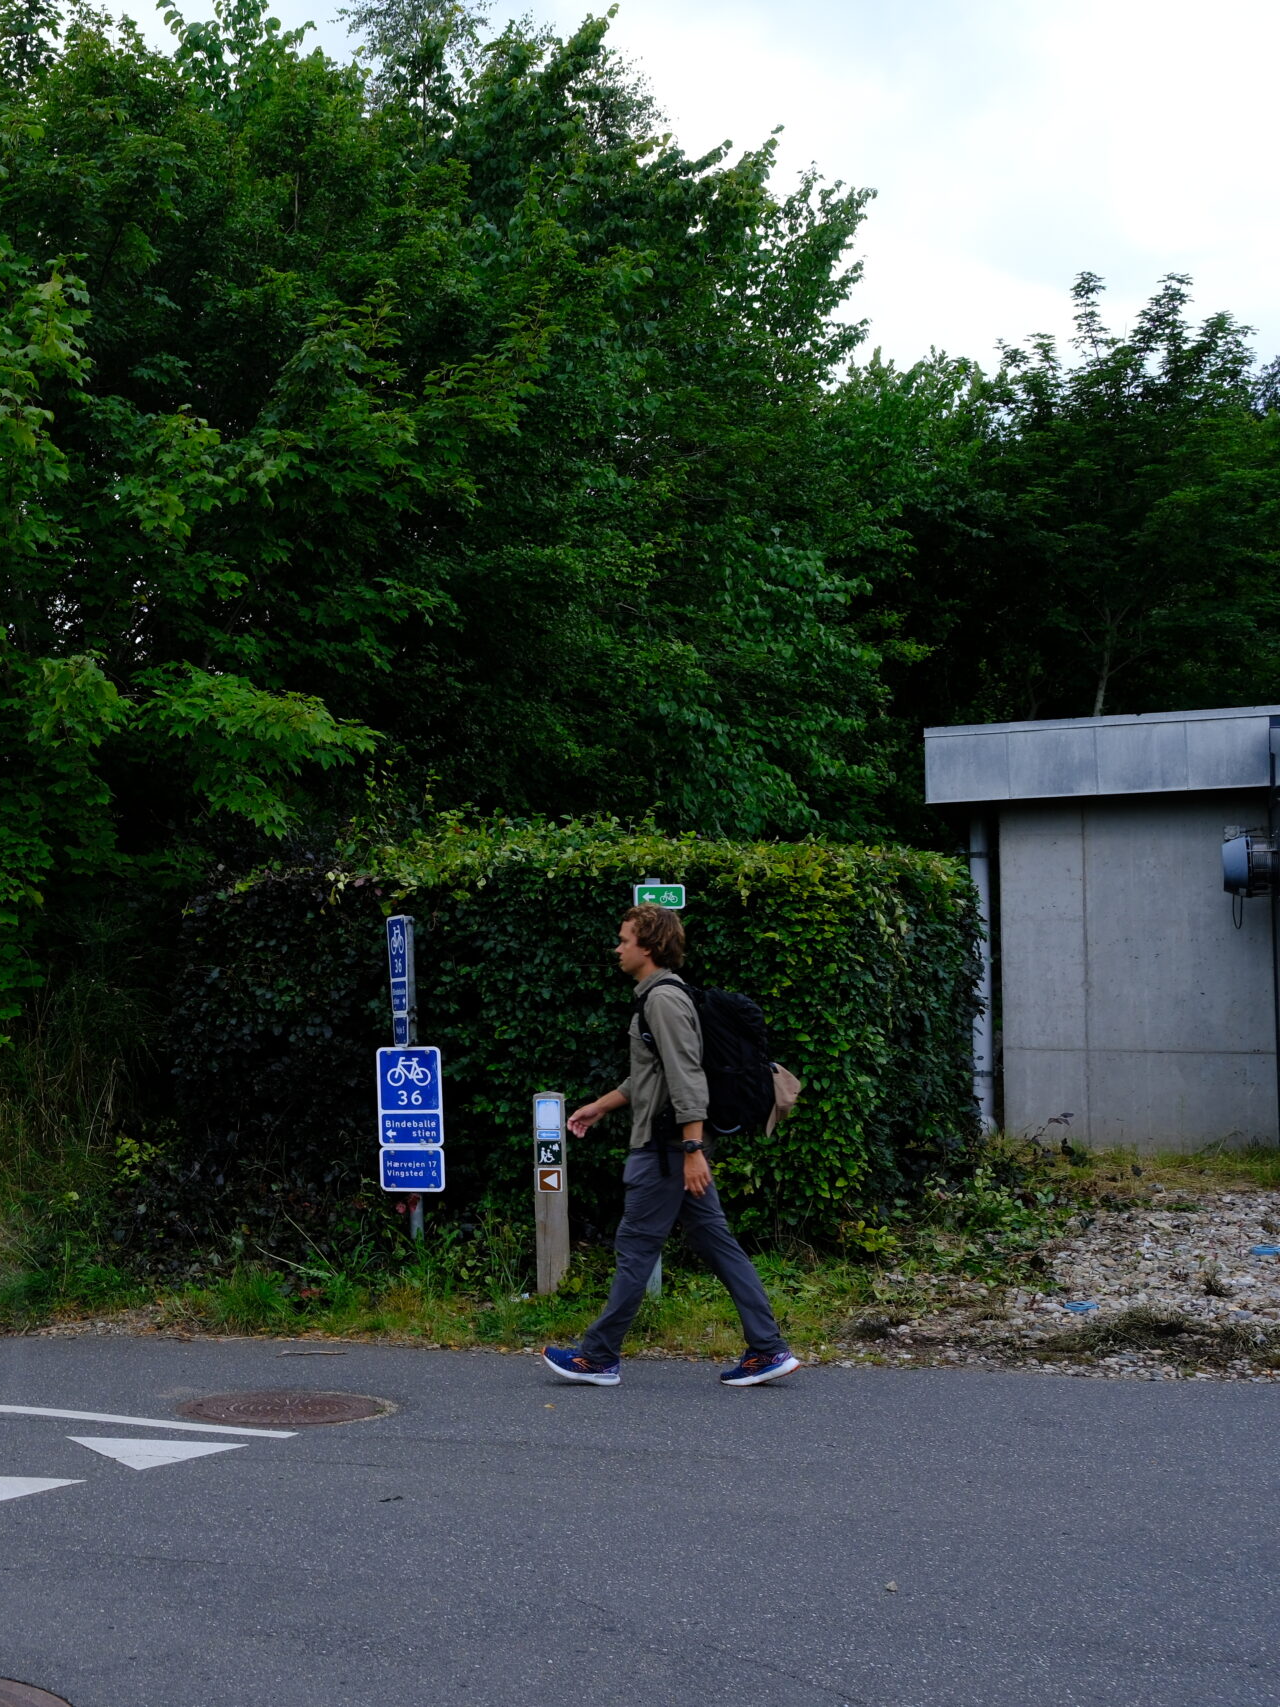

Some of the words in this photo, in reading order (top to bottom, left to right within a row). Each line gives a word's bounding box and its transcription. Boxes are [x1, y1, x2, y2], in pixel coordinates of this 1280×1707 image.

[394, 958, 402, 973] 36
[397, 1090, 423, 1106] 36
[385, 1120, 437, 1128] Bindeballe
[412, 1129, 437, 1137] stien
[386, 1160, 426, 1168] Hærvejen
[428, 1160, 437, 1168] 17
[387, 1169, 424, 1178] Vingsted
[431, 1169, 437, 1177] 6
